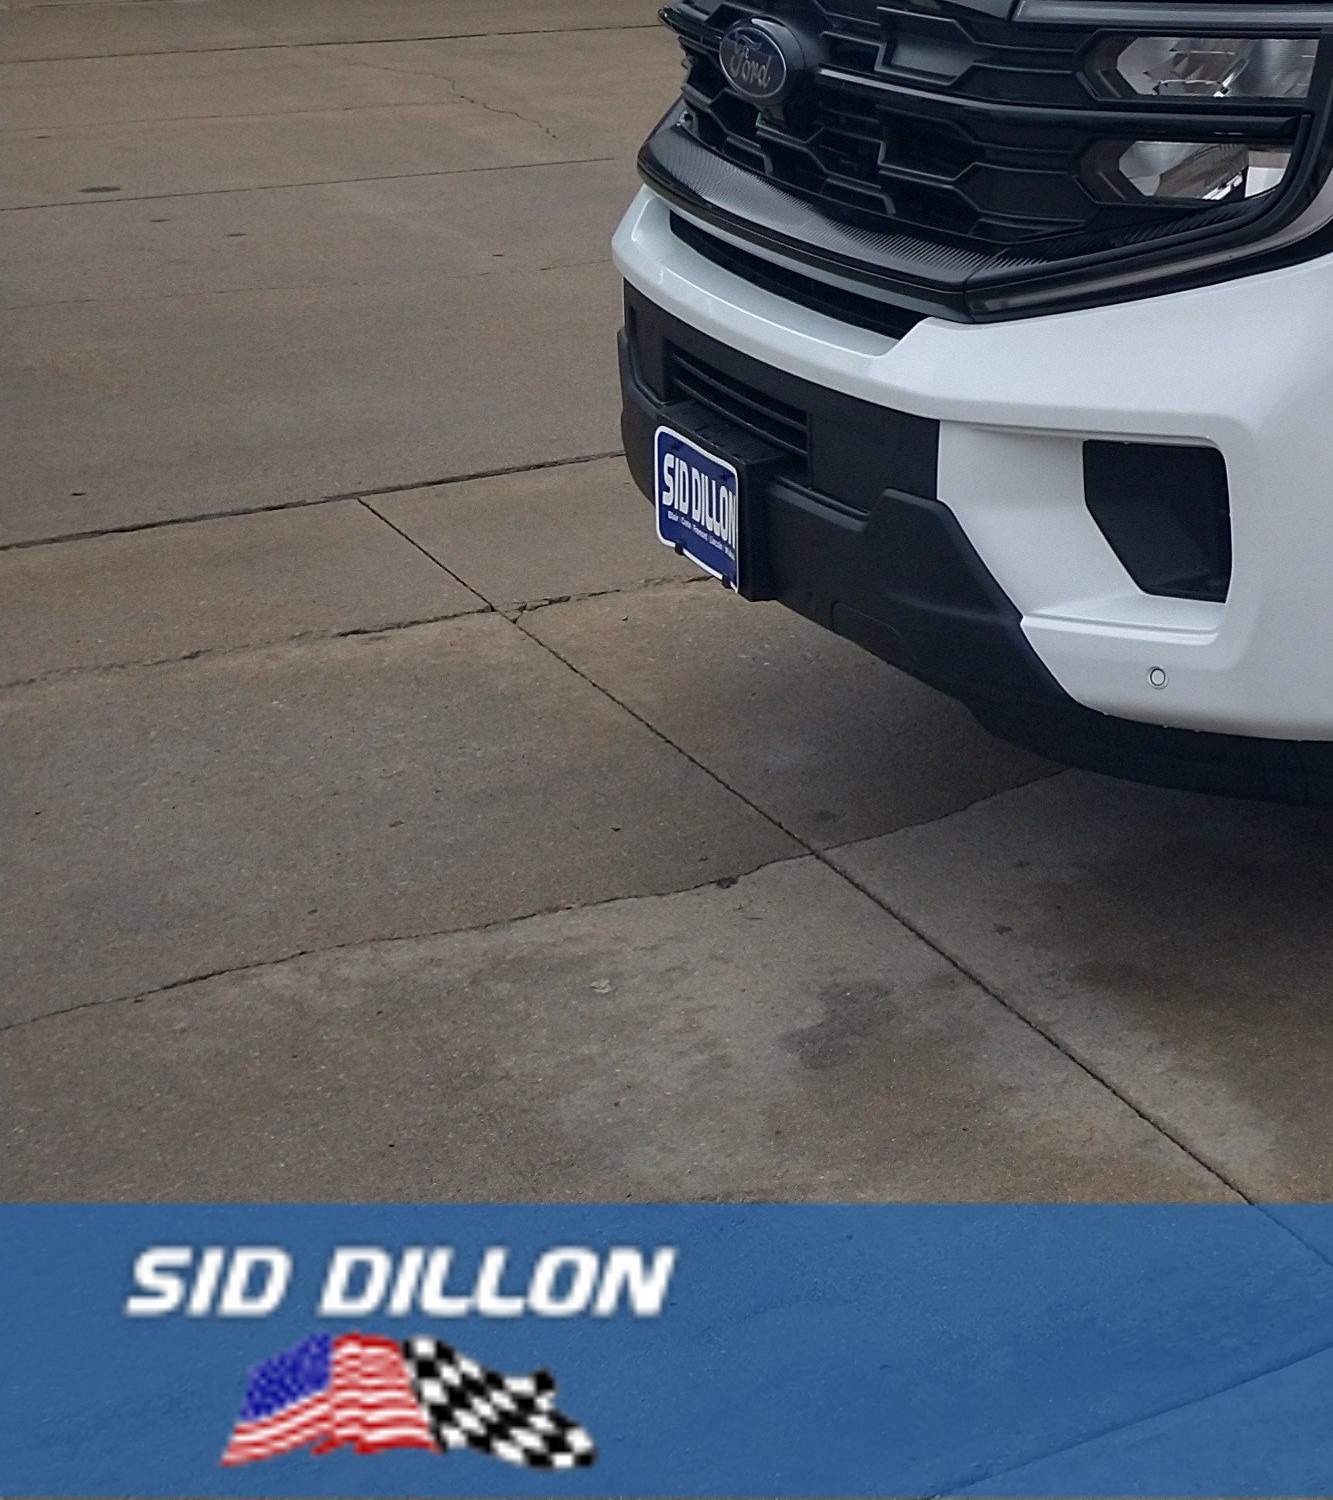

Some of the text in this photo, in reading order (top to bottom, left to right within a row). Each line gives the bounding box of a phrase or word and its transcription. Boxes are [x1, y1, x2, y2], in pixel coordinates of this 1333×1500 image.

[729, 32, 772, 89] Ford
[662, 453, 736, 550] SID DILLON
